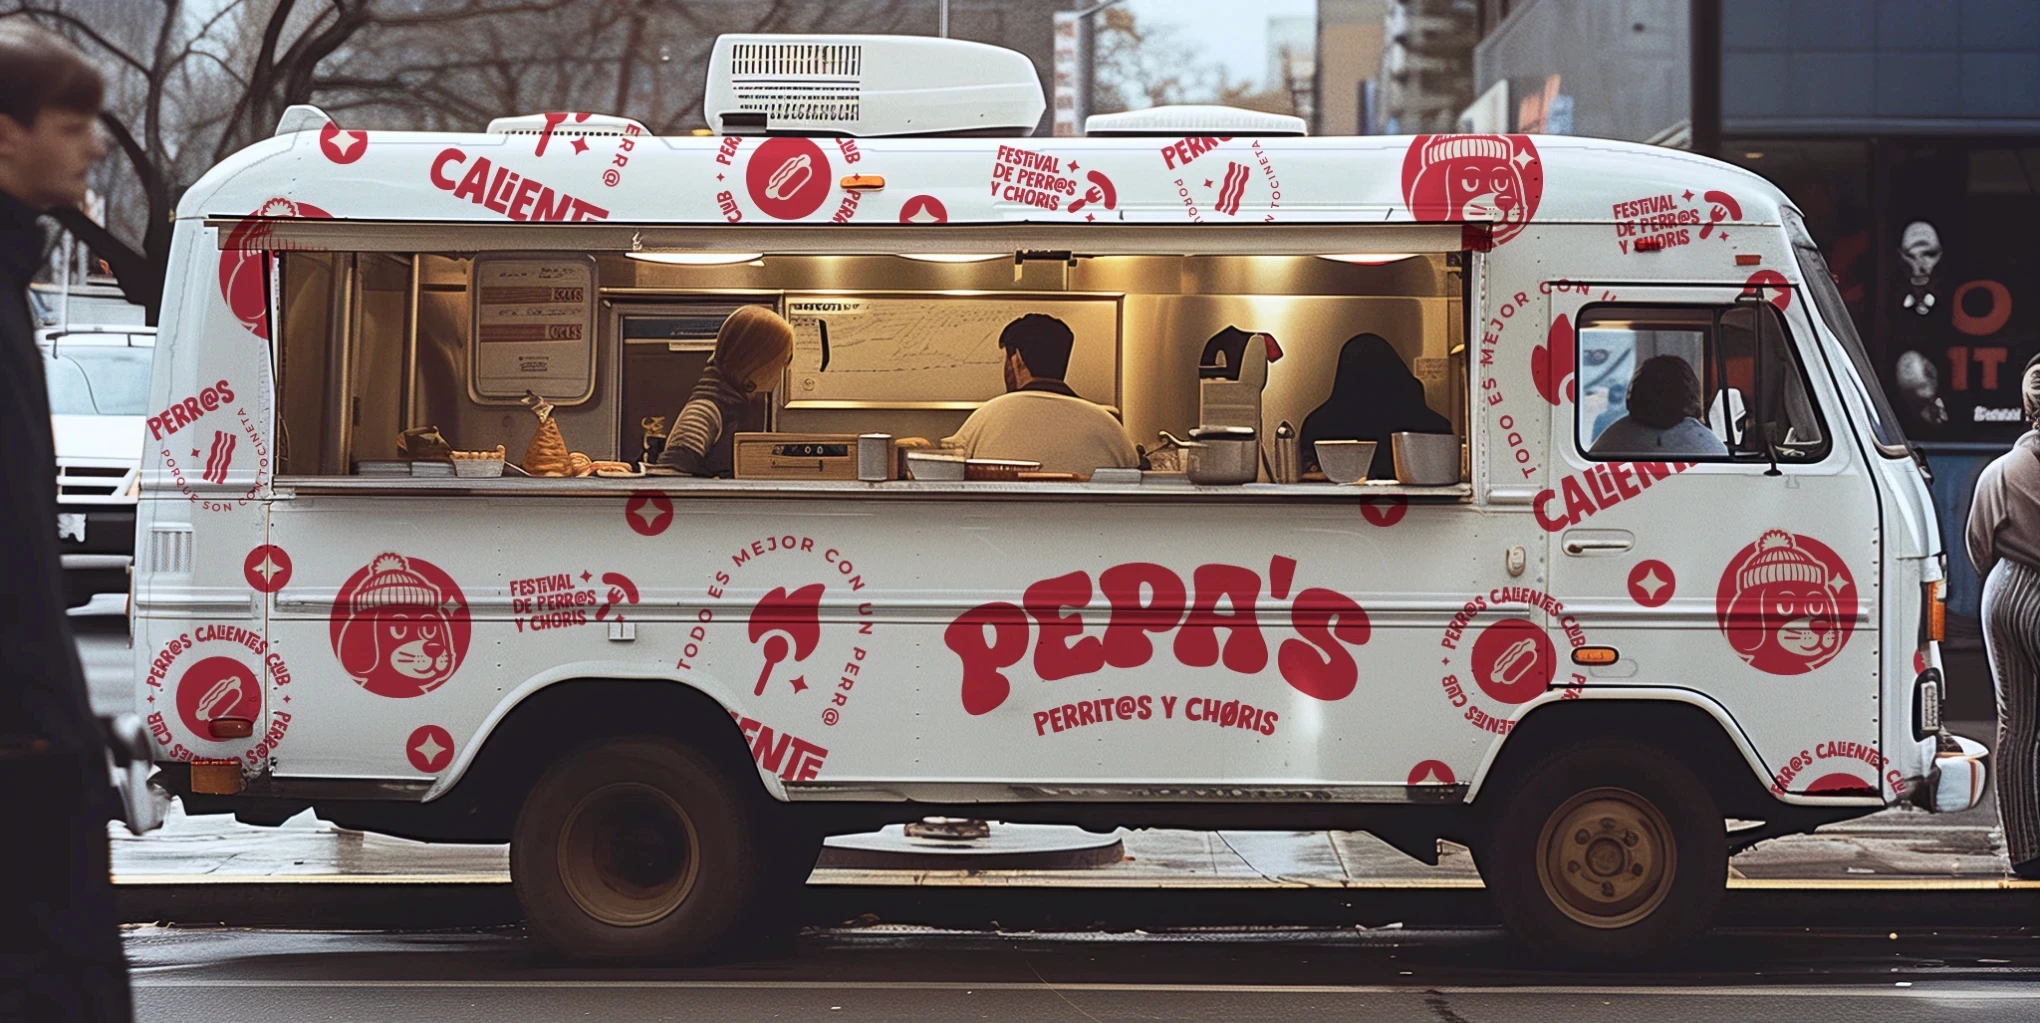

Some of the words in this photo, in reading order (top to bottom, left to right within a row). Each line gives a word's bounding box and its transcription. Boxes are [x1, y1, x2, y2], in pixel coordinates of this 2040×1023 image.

[716, 136, 742, 166] PER
[430, 148, 610, 221] CALiENT
[991, 181, 1001, 196] Y
[1003, 186, 1060, 211] CHORIS
[992, 163, 1014, 182] DE
[1017, 169, 1077, 196] PERR@S
[1174, 178, 1204, 223] PORQU
[1251, 139, 1281, 209] TOCINETA
[717, 190, 742, 222] CLUB
[1616, 220, 1636, 237] DE
[1640, 209, 1700, 234] PERR@S
[1618, 240, 1628, 255] Y
[1539, 279, 1590, 296] CON
[1480, 292, 1530, 365] MEJOR
[1482, 378, 1504, 406] ES
[146, 380, 235, 442] PERR@S
[238, 407, 268, 476] TOCINETA
[1500, 414, 1536, 479] TODO
[161, 449, 199, 503] PORQUE
[202, 501, 232, 512] SON
[238, 481, 263, 506] CON
[732, 536, 814, 567] MEJOR
[708, 571, 730, 599] ES
[824, 548, 865, 592] CON
[513, 598, 532, 614] DE
[537, 590, 597, 611] PERR@S
[858, 602, 873, 635] UN
[515, 618, 524, 632] Y
[530, 609, 587, 631] CHORIS
[944, 554, 1372, 717] PEPA'S
[1441, 596, 1487, 650] PERR@S
[1560, 616, 1586, 648] CLUB
[676, 608, 712, 671] TODO
[146, 634, 192, 688] PERR@S
[265, 653, 291, 686] CLUB
[822, 647, 866, 726] PERR@
[1442, 674, 1468, 708] CLUB
[147, 712, 172, 746] CLUB
[1033, 695, 1152, 736] PERRIT@S
[1160, 696, 1178, 718] Y
[246, 711, 292, 765] PERR@S
